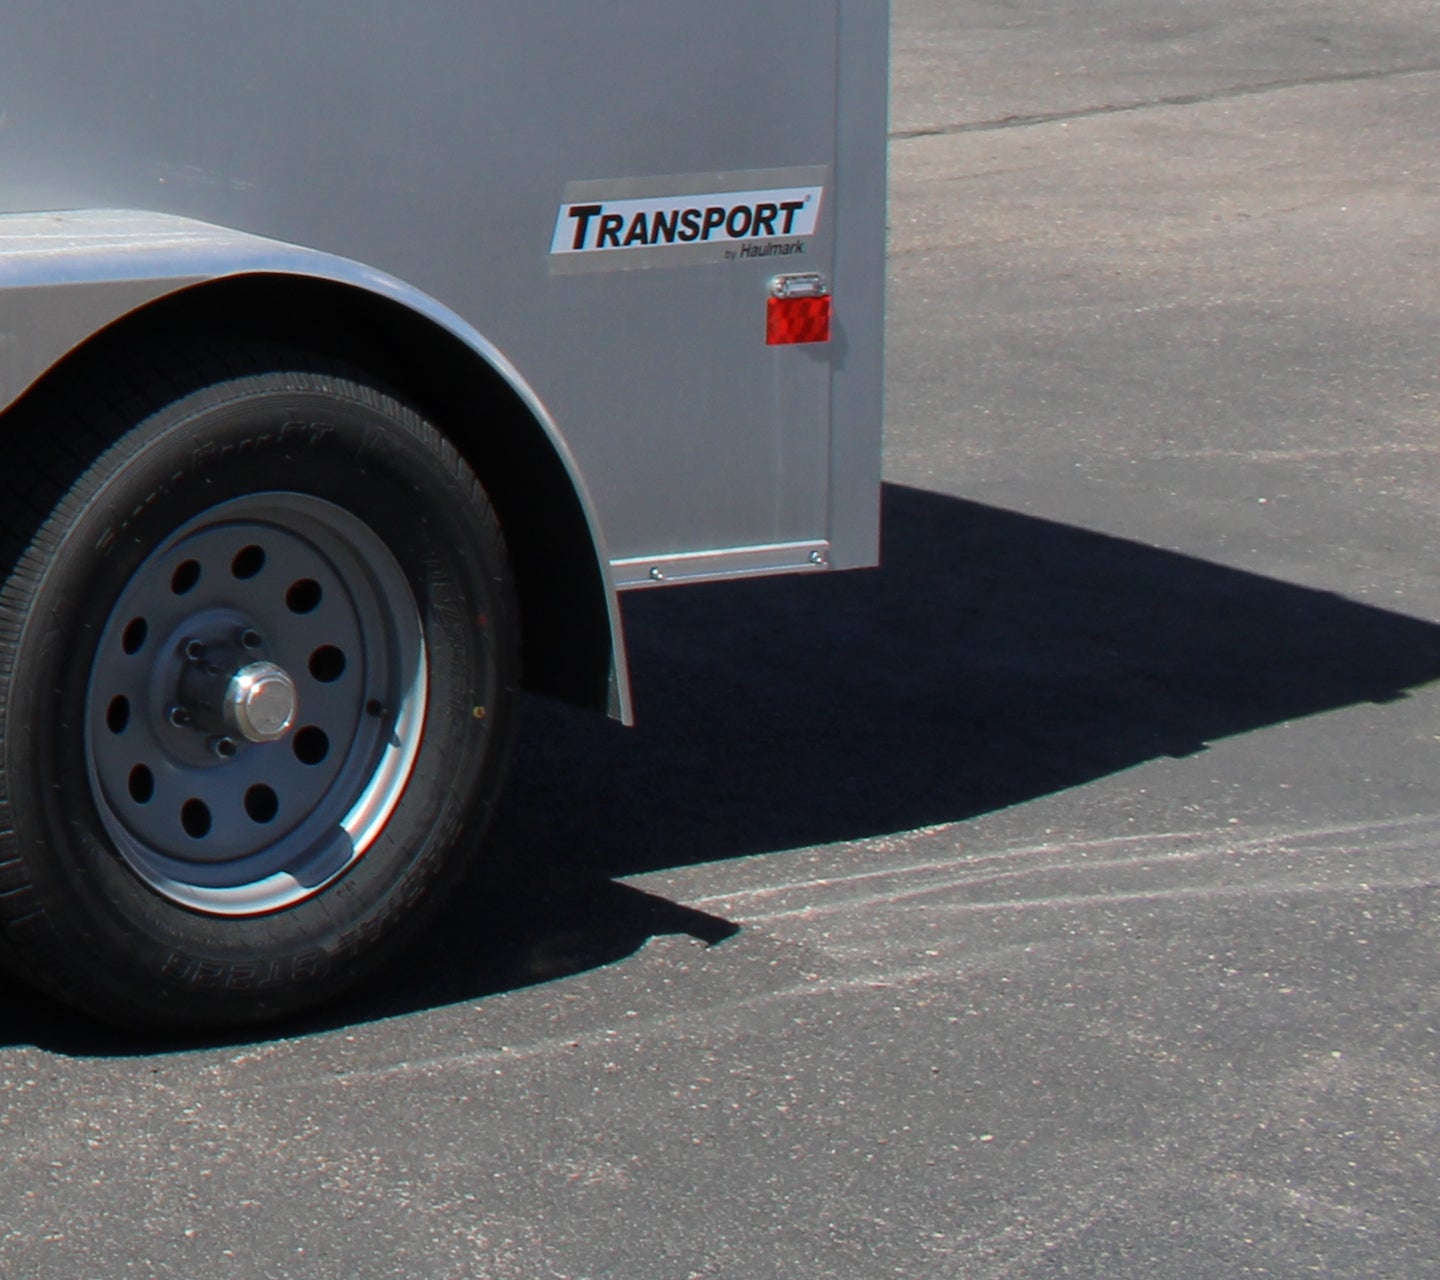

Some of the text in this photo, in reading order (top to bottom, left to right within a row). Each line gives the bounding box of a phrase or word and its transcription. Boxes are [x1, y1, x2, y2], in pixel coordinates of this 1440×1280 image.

[568, 201, 804, 250] TRANSPORT
[724, 240, 804, 260] by Haulmark
